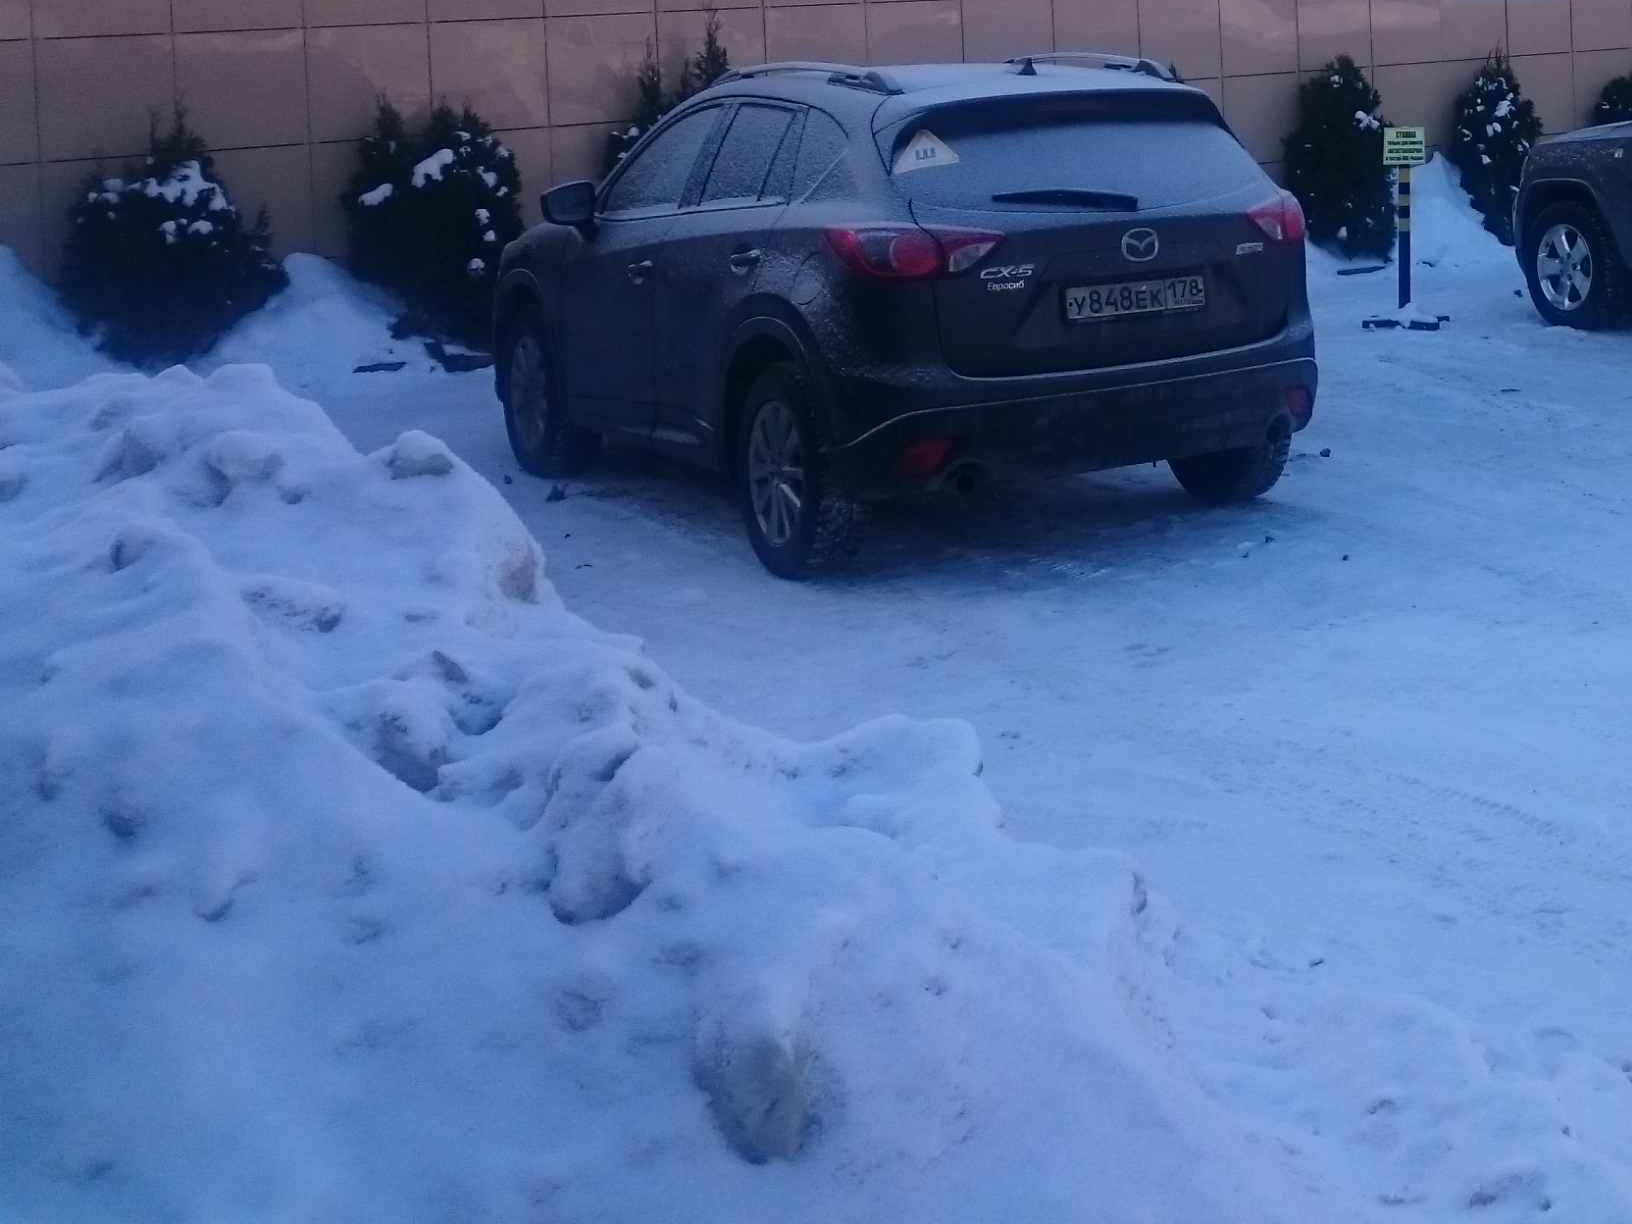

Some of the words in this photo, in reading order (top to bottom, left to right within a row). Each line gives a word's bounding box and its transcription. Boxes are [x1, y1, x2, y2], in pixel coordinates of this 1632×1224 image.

[980, 264, 1035, 279] CX-5
[987, 279, 1025, 291] Евросиб
[1073, 286, 1164, 316] У848ЕК
[1166, 279, 1200, 299] 178
